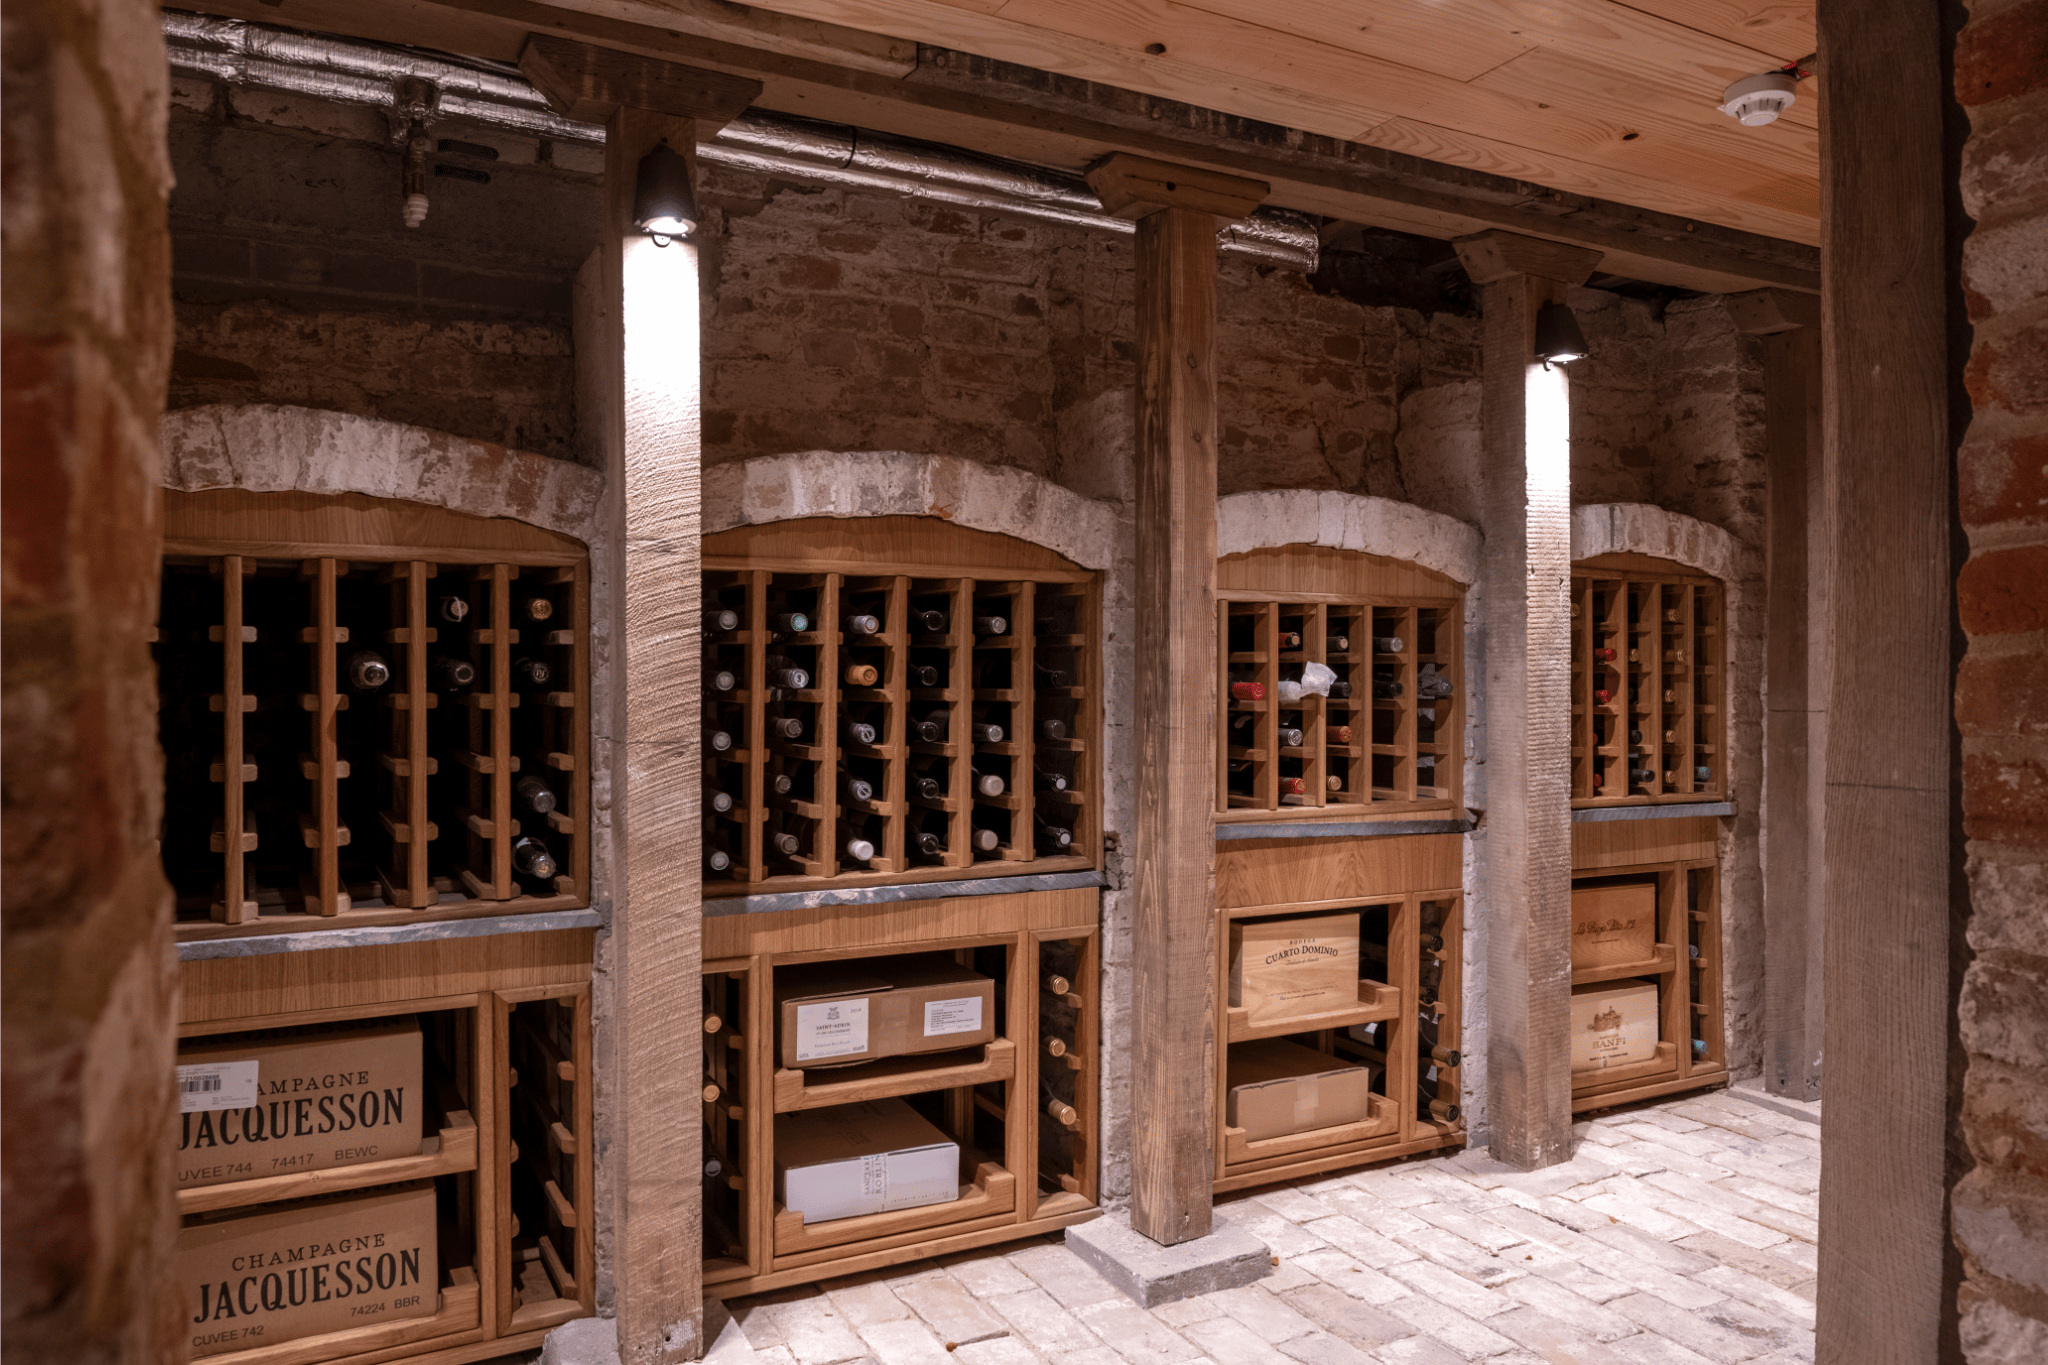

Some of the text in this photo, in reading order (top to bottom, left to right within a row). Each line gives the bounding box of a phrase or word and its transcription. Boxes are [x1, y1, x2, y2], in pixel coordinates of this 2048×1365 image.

[1265, 945, 1339, 965] CUARTO DOMINIO
[1592, 1037, 1626, 1049] BANFI
[257, 1070, 370, 1096] AMPAGNE
[178, 1087, 404, 1150] JACQUESSON
[178, 1145, 379, 1182] UVEE 744 74417 BEWC
[232, 1233, 386, 1272] CHAMPAGNE
[193, 1247, 421, 1324] JACQUESSON
[192, 1295, 421, 1347] CUVEE 742 74224 BBR
